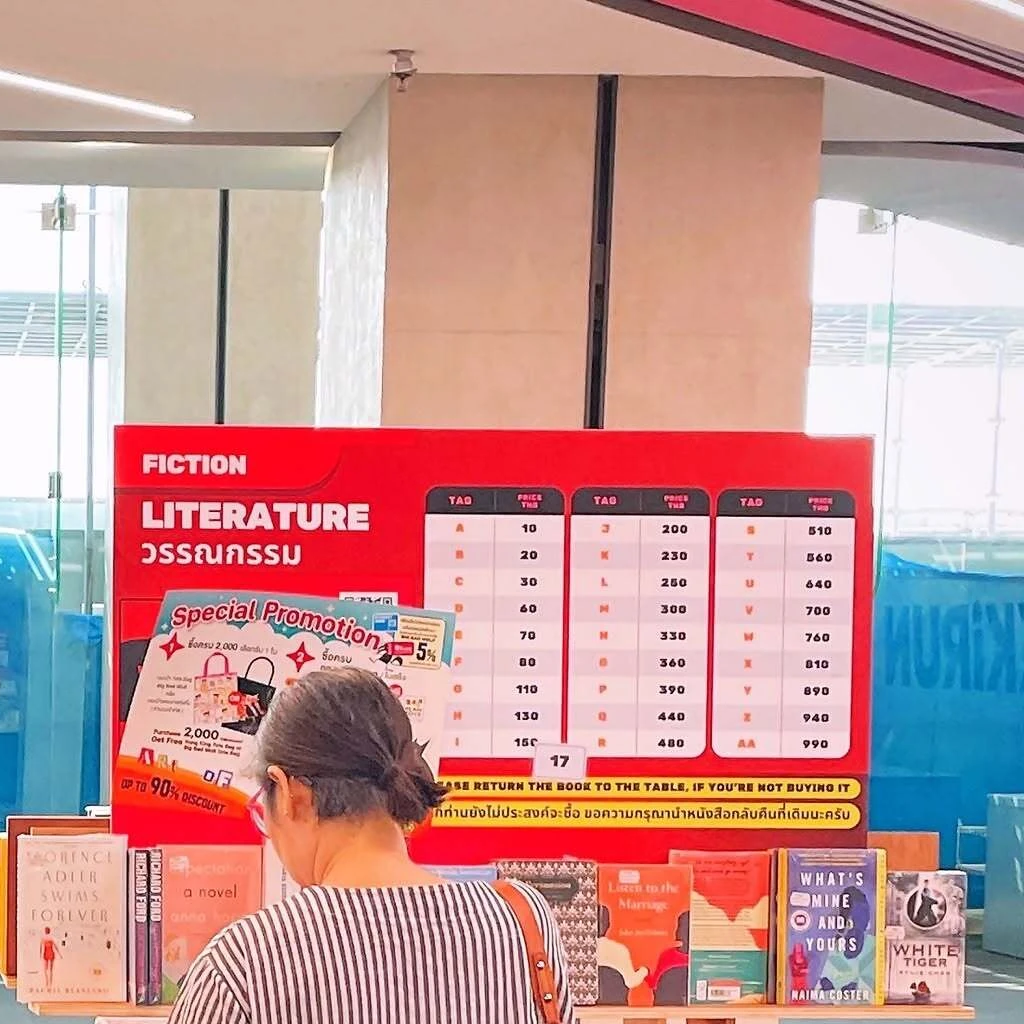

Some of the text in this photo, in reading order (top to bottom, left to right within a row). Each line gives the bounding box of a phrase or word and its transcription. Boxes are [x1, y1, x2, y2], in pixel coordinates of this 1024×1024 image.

[142, 454, 247, 475] FICTION
[448, 496, 472, 505] TAG
[593, 496, 617, 505] TAG
[740, 498, 764, 507] TAG
[142, 501, 370, 531] LITERATURE
[455, 523, 537, 533] A 10
[601, 523, 688, 534] J 200
[808, 526, 832, 536] 510
[141, 542, 302, 566] วรรณกรรม
[519, 550, 538, 560] 20
[600, 550, 688, 561] K 230
[746, 552, 833, 563] T 560
[454, 576, 538, 587] C 30
[600, 577, 688, 588] L 250
[745, 579, 832, 589] U 640
[519, 603, 537, 614] 60
[660, 604, 687, 614] 300
[745, 605, 831, 616] V 700
[172, 600, 381, 650] Special Promotion
[519, 630, 536, 641] 70
[659, 631, 687, 641] 330
[743, 631, 830, 643] W 760
[216, 642, 239, 652] 2,000
[416, 642, 436, 662] 5%
[297, 652, 304, 662] 2
[519, 657, 536, 667] 80
[659, 658, 686, 668] 360
[805, 659, 829, 669] 810
[515, 684, 538, 694] 110
[598, 684, 685, 695] P 390
[743, 685, 830, 697] Y 890
[514, 711, 539, 721] 130
[657, 711, 685, 722] 440
[802, 713, 829, 723] 940
[184, 727, 219, 740] 2,000
[597, 737, 685, 748] R 480
[737, 739, 829, 749] AA 990
[550, 755, 569, 767] 17
[438, 781, 851, 793] ASE RETURN THE BOOK TO THE TABLE, IF YOU'RE NOT BUYING IT
[121, 776, 226, 814] UP TO 90% DISCOUNT
[435, 803, 580, 819] กท่านยังไม่ประสงค์จะซื้อ
[44, 850, 113, 866] ORENCE
[800, 872, 864, 886] WHAT'S
[136, 852, 147, 922] RICHARD FORD
[150, 850, 162, 922] RICHARD FORD
[184, 883, 237, 898] a novel
[608, 880, 679, 894] Listen to the
[41, 890, 99, 902] SWIMS
[811, 894, 850, 908] MINE
[619, 898, 668, 913] Marriage
[31, 909, 109, 922] FOREVER
[818, 916, 845, 929] AND
[806, 938, 857, 951] YOURS
[892, 944, 960, 957] WHITE
[904, 958, 948, 967] TIGER
[792, 989, 870, 1000] NAIMA COSTER
